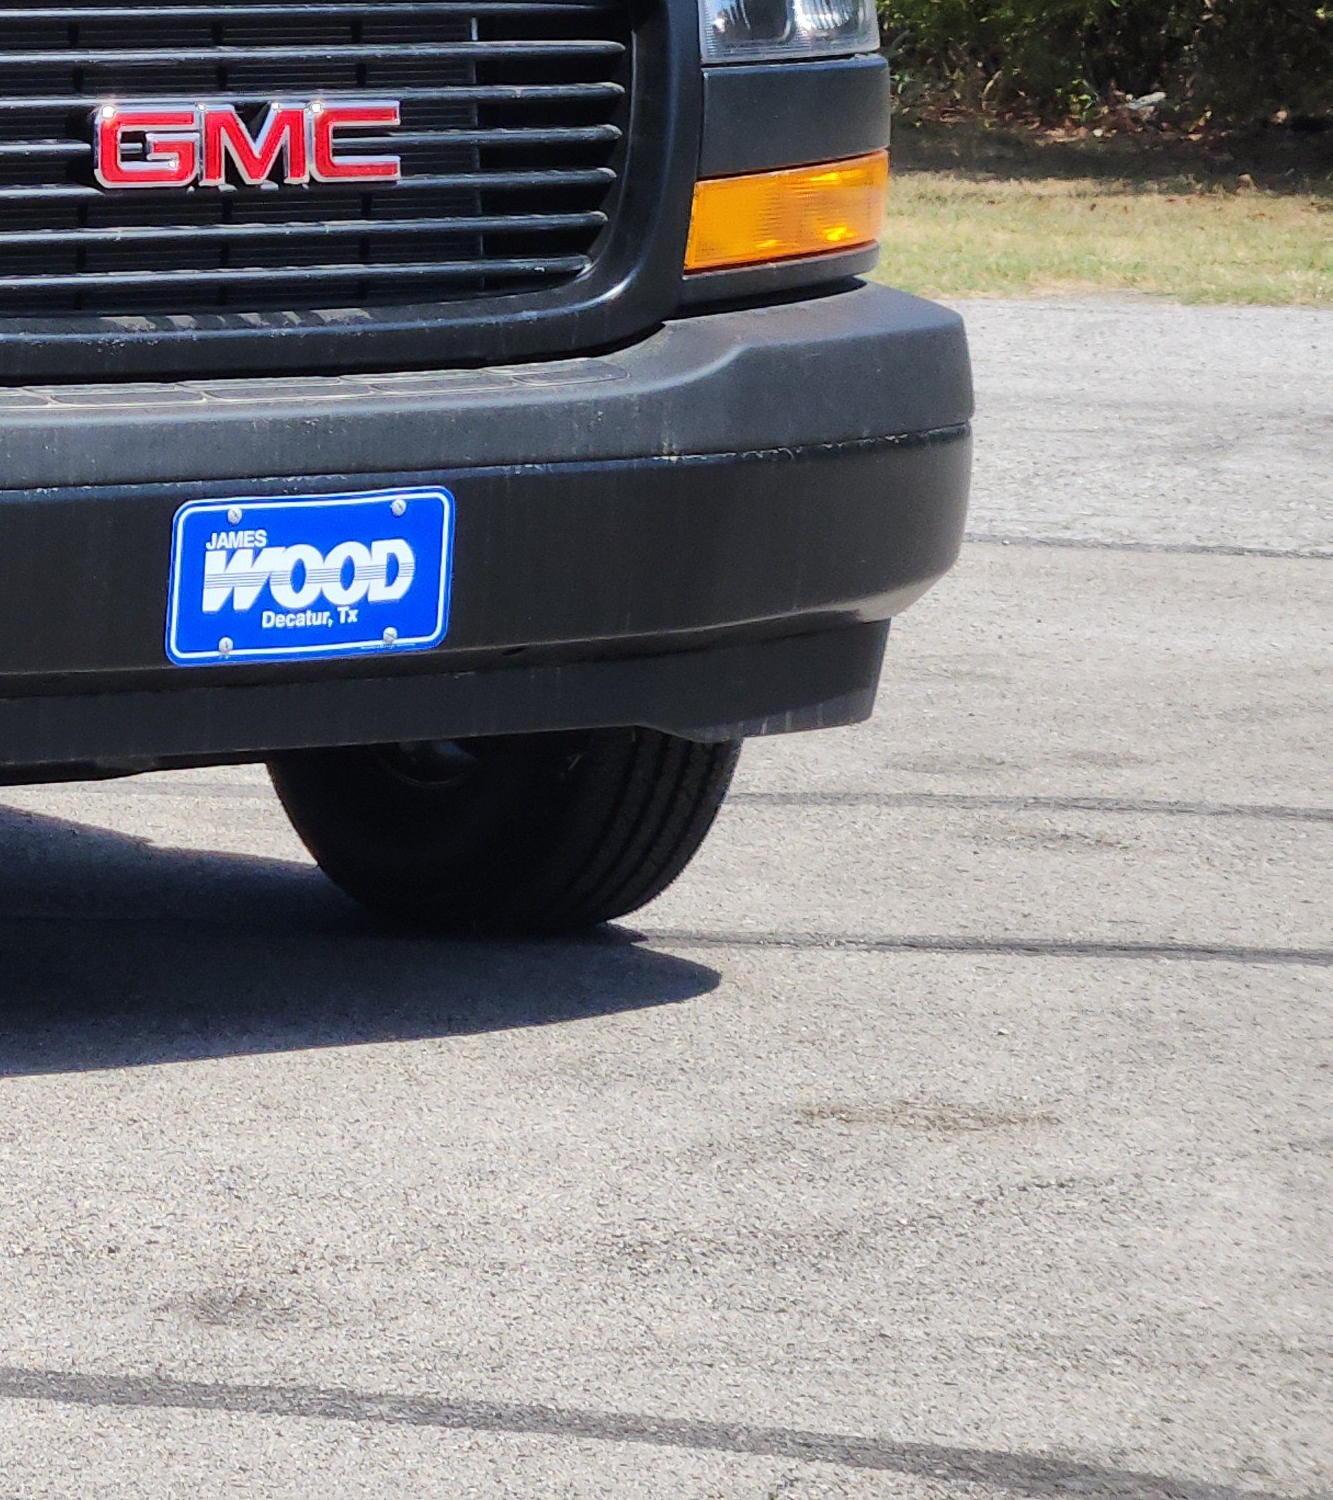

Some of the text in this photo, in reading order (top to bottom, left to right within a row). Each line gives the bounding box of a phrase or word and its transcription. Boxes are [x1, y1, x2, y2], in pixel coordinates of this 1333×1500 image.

[94, 100, 401, 188] GMC
[206, 530, 268, 550] JAMES
[202, 539, 415, 612] WOOD
[261, 605, 359, 629] Decatur, Tx
